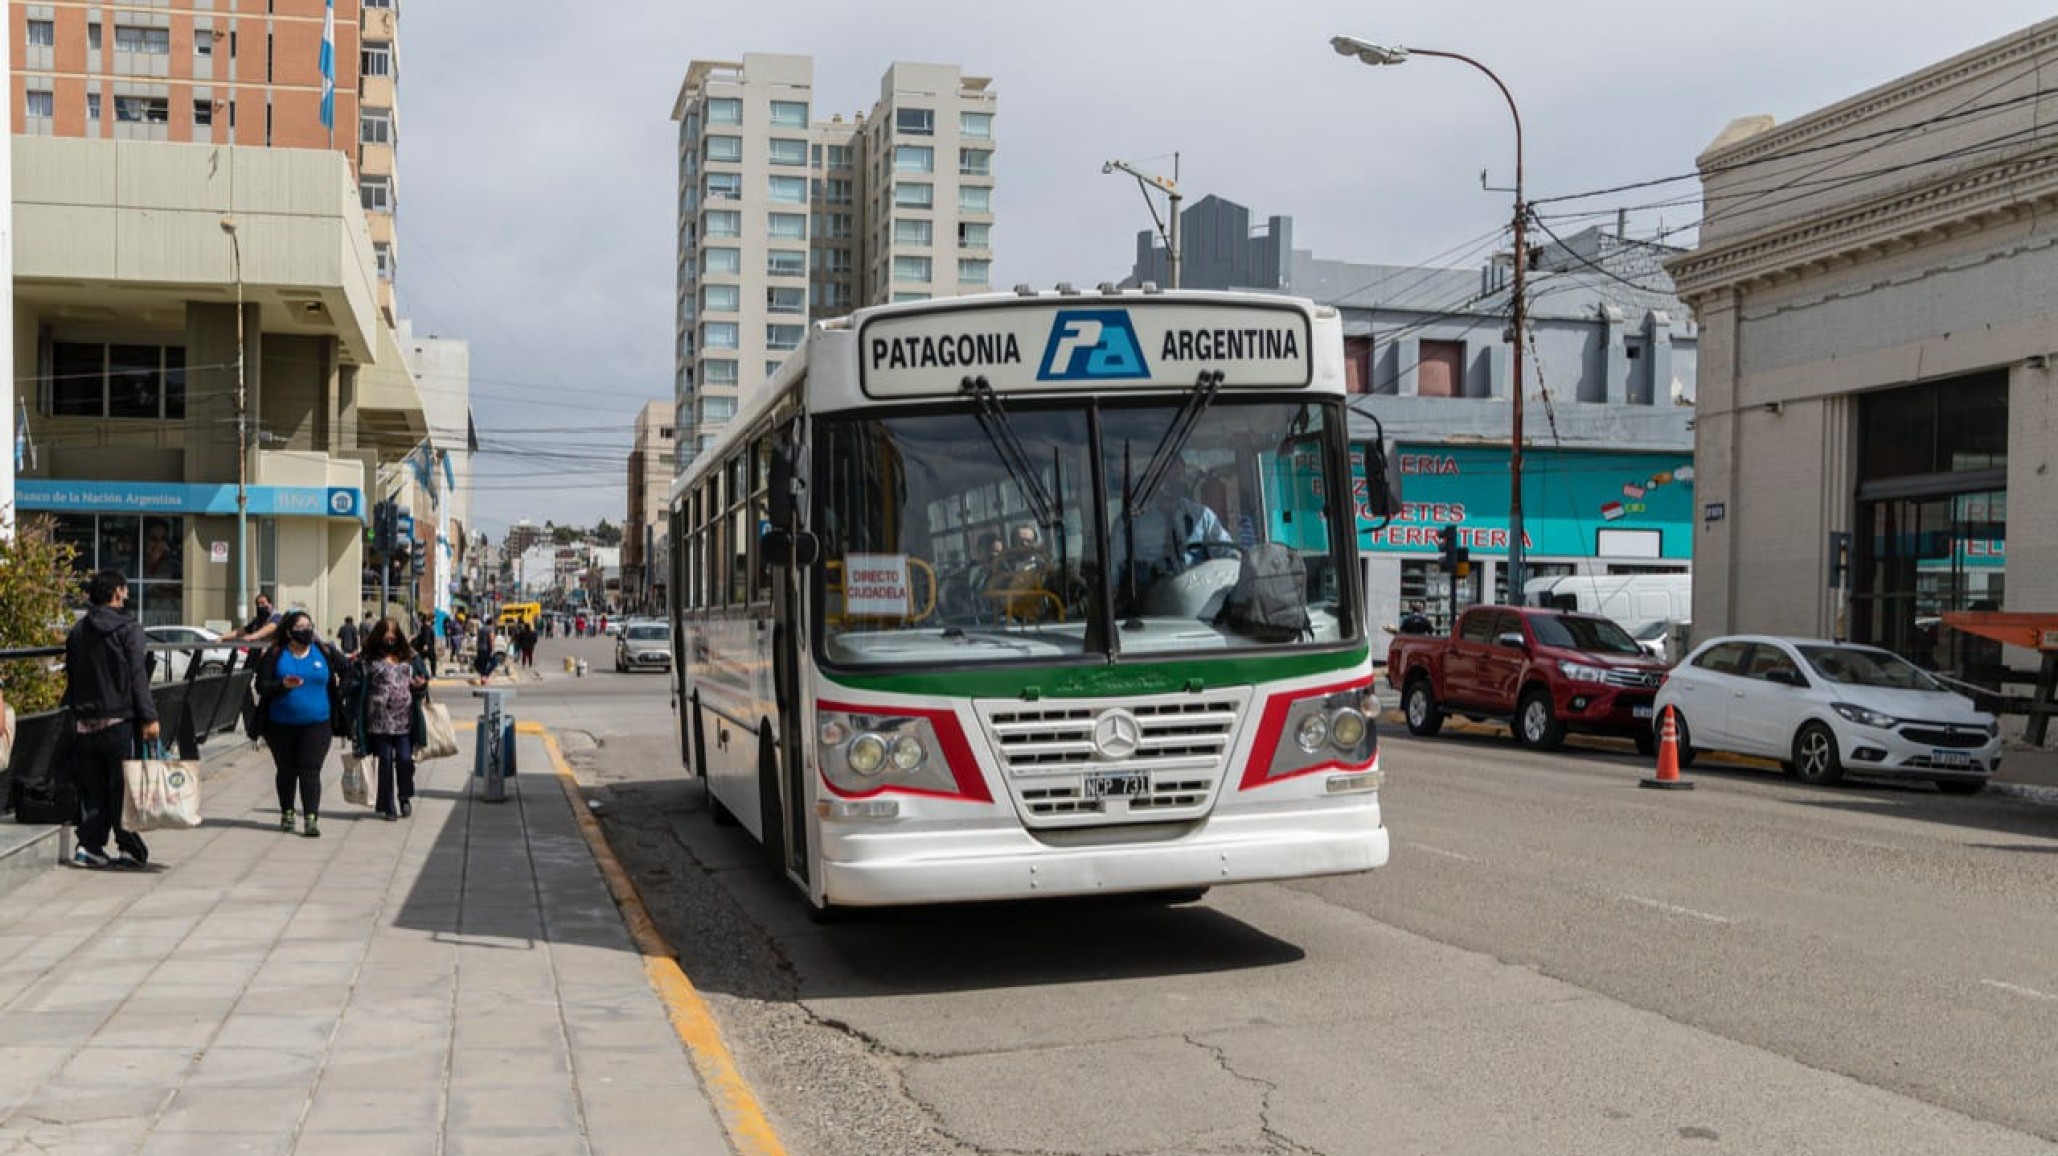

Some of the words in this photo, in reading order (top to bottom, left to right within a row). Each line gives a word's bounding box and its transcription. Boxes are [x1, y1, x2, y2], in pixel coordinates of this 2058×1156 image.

[872, 332, 1022, 369] PATAGONIA
[1161, 329, 1299, 362] ARGENTINA
[52, 490, 66, 503] de
[69, 490, 80, 503] la
[126, 493, 181, 506] Argentina
[1371, 526, 1533, 548] FERRTERA
[853, 570, 899, 583] DIRECTO
[848, 586, 905, 600] CIUDADELA
[1121, 776, 1147, 794] 731
